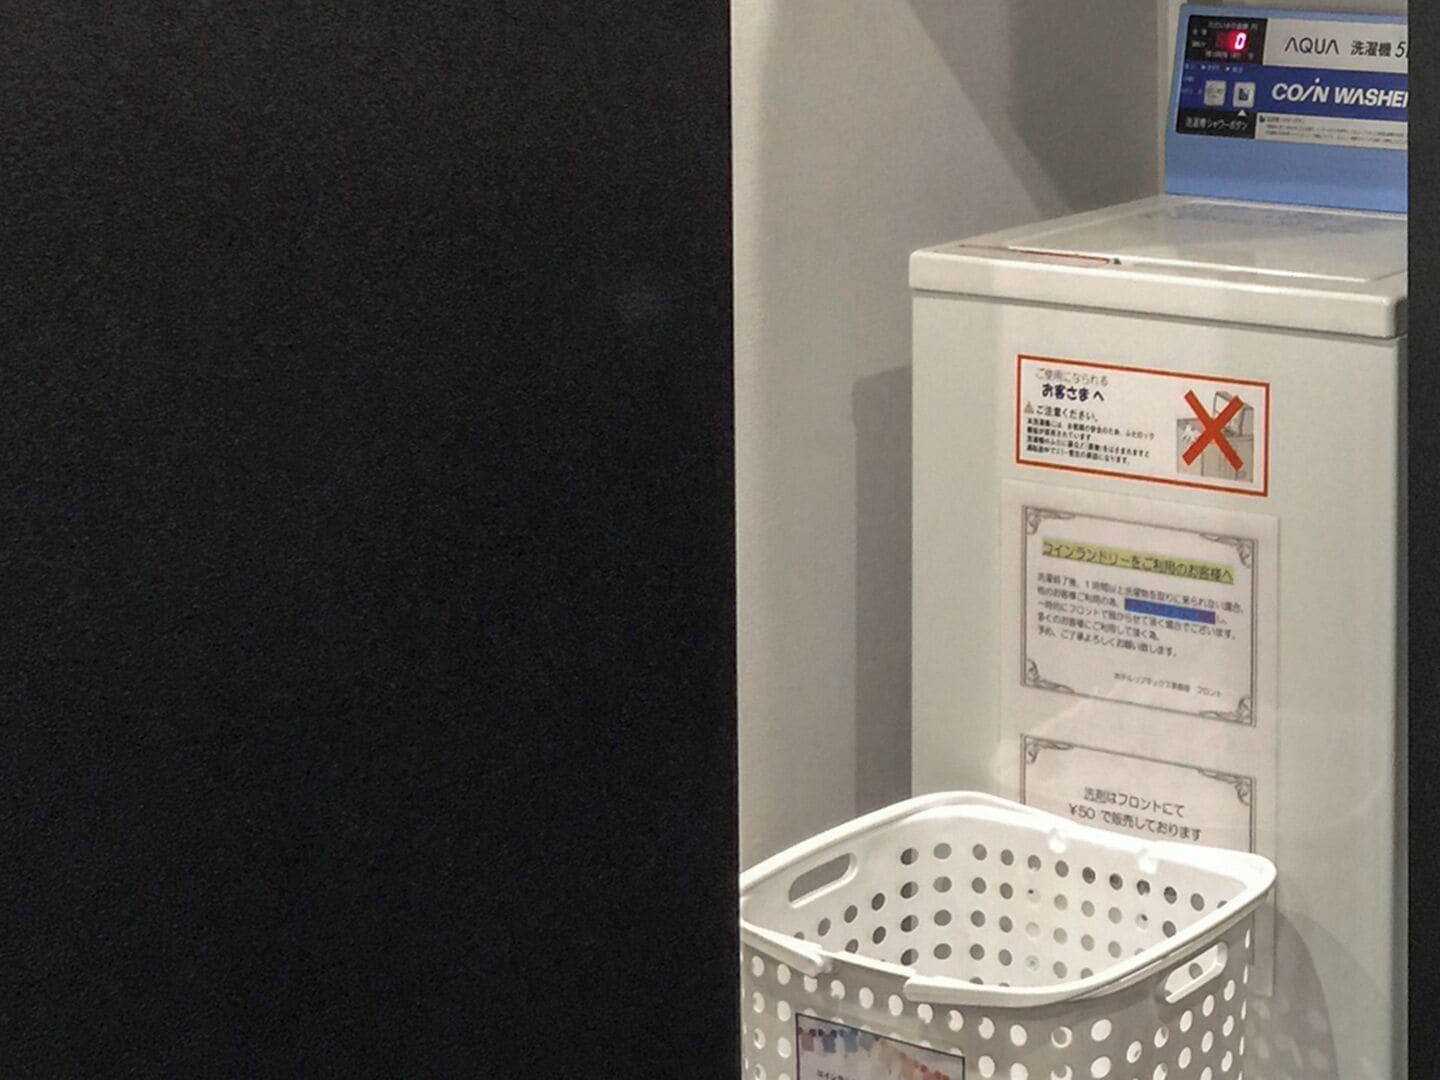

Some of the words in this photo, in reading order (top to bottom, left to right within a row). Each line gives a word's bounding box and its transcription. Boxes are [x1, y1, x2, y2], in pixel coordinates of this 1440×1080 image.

[1284, 37, 1339, 55] AQUA
[1271, 77, 1329, 104] COIN
[1042, 541, 1234, 583] コインランドリーをご利用のお客様へ
